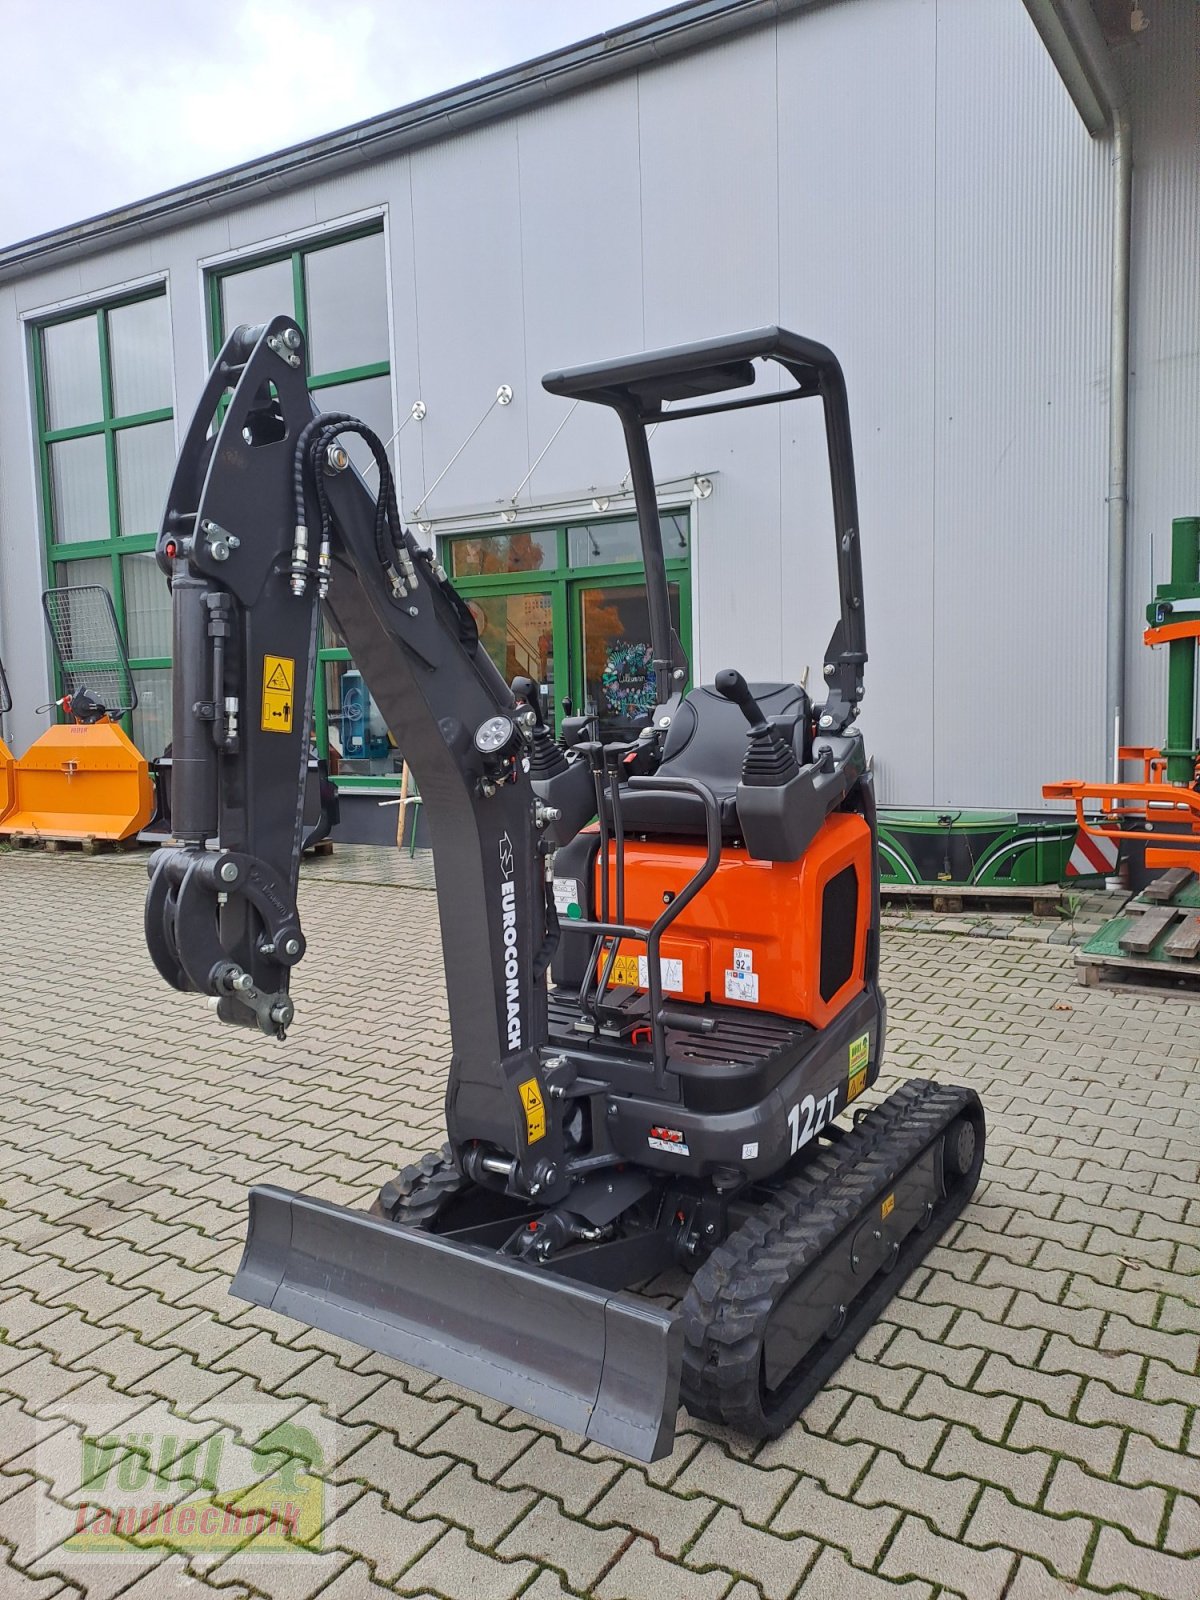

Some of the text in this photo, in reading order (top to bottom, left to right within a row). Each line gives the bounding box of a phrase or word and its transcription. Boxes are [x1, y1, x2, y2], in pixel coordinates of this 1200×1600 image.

[501, 880, 521, 1051] EUROCOMACH
[735, 959, 746, 970] 92
[788, 1087, 839, 1156] 12ZT
